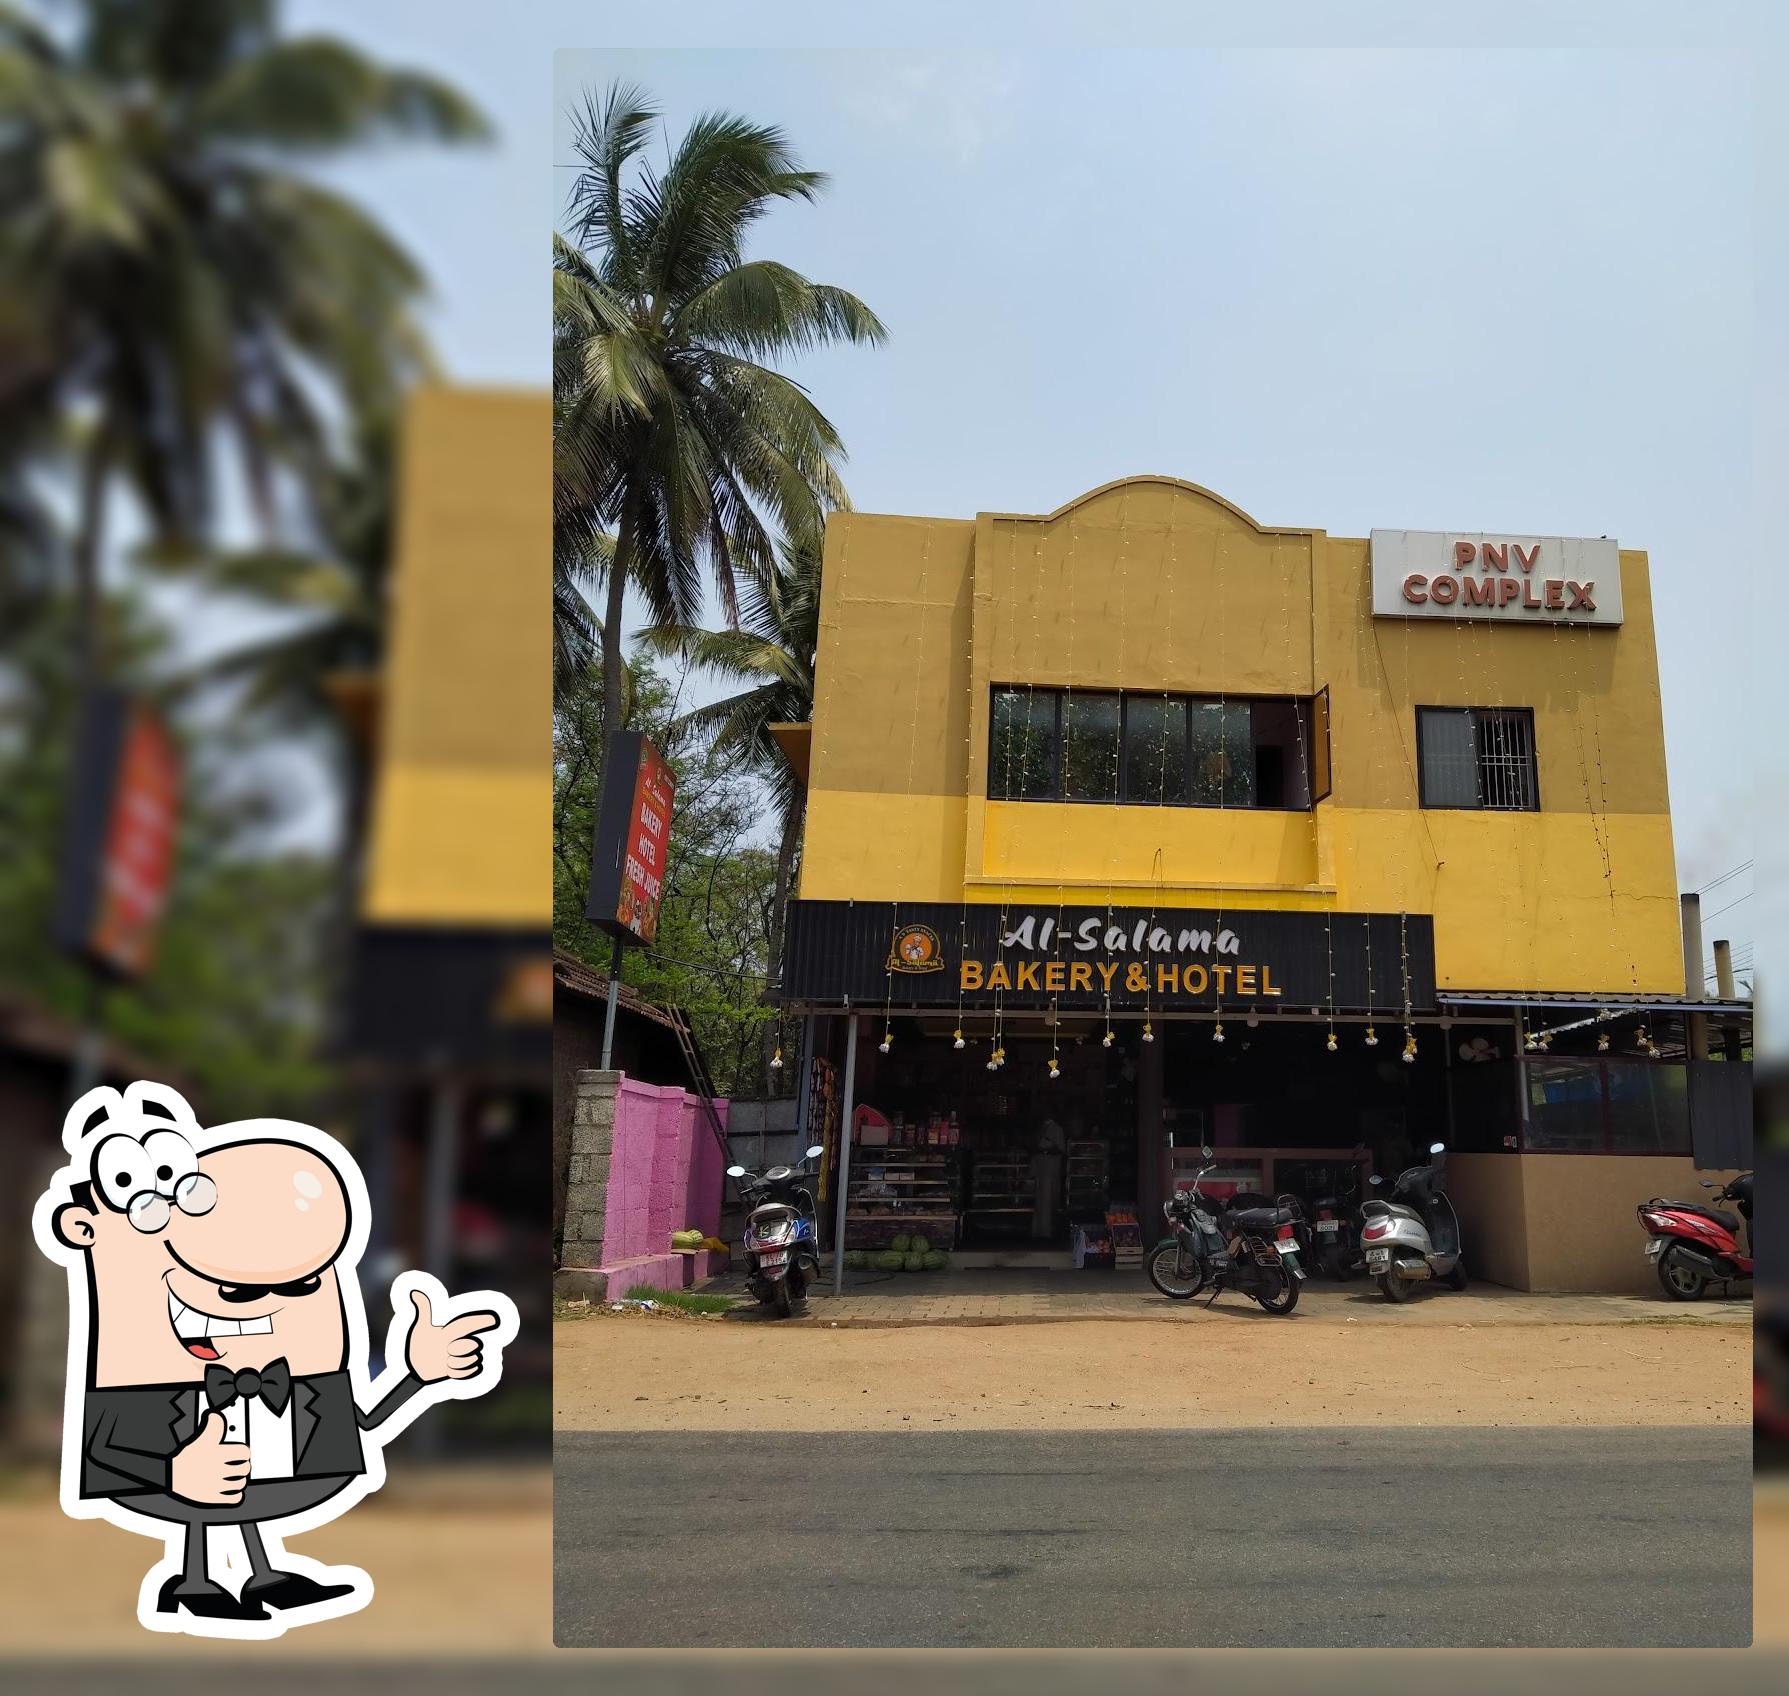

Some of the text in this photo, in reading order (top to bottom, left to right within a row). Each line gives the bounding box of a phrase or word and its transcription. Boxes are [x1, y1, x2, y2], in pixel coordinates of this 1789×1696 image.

[1454, 541, 1541, 573] PNV
[1402, 574, 1597, 611] COMPLEX
[640, 802, 663, 839] BAKERY
[638, 833, 656, 866] HOTEL
[625, 854, 645, 887] FRESH
[643, 872, 661, 901] JUICE
[1003, 915, 1241, 956] Al-Salama
